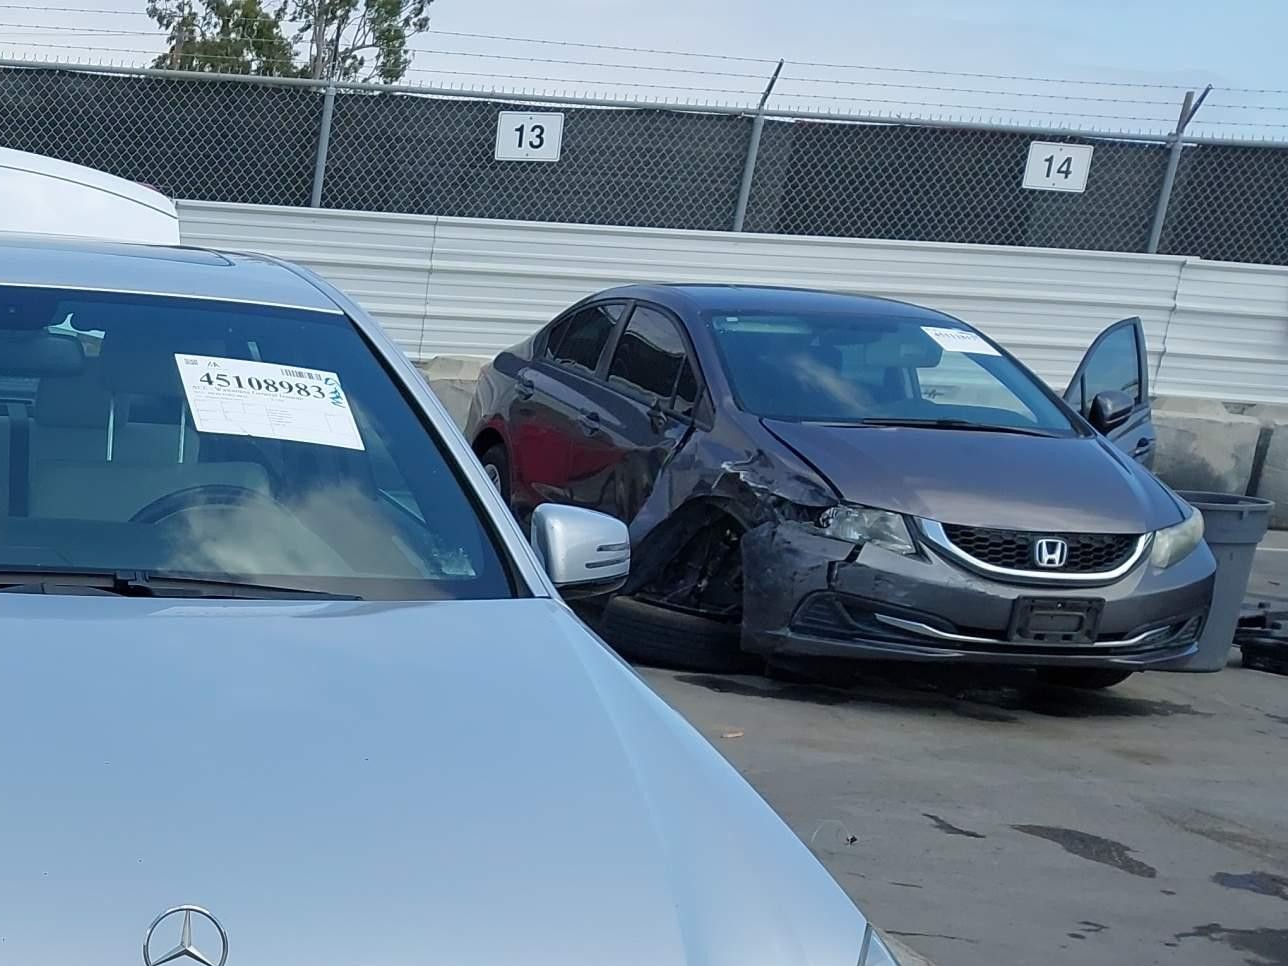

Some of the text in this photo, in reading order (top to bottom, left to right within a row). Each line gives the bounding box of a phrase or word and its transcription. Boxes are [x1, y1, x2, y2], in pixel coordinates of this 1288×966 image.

[514, 124, 546, 149] 13
[1044, 155, 1074, 179] 14
[199, 371, 327, 399] 45108983
